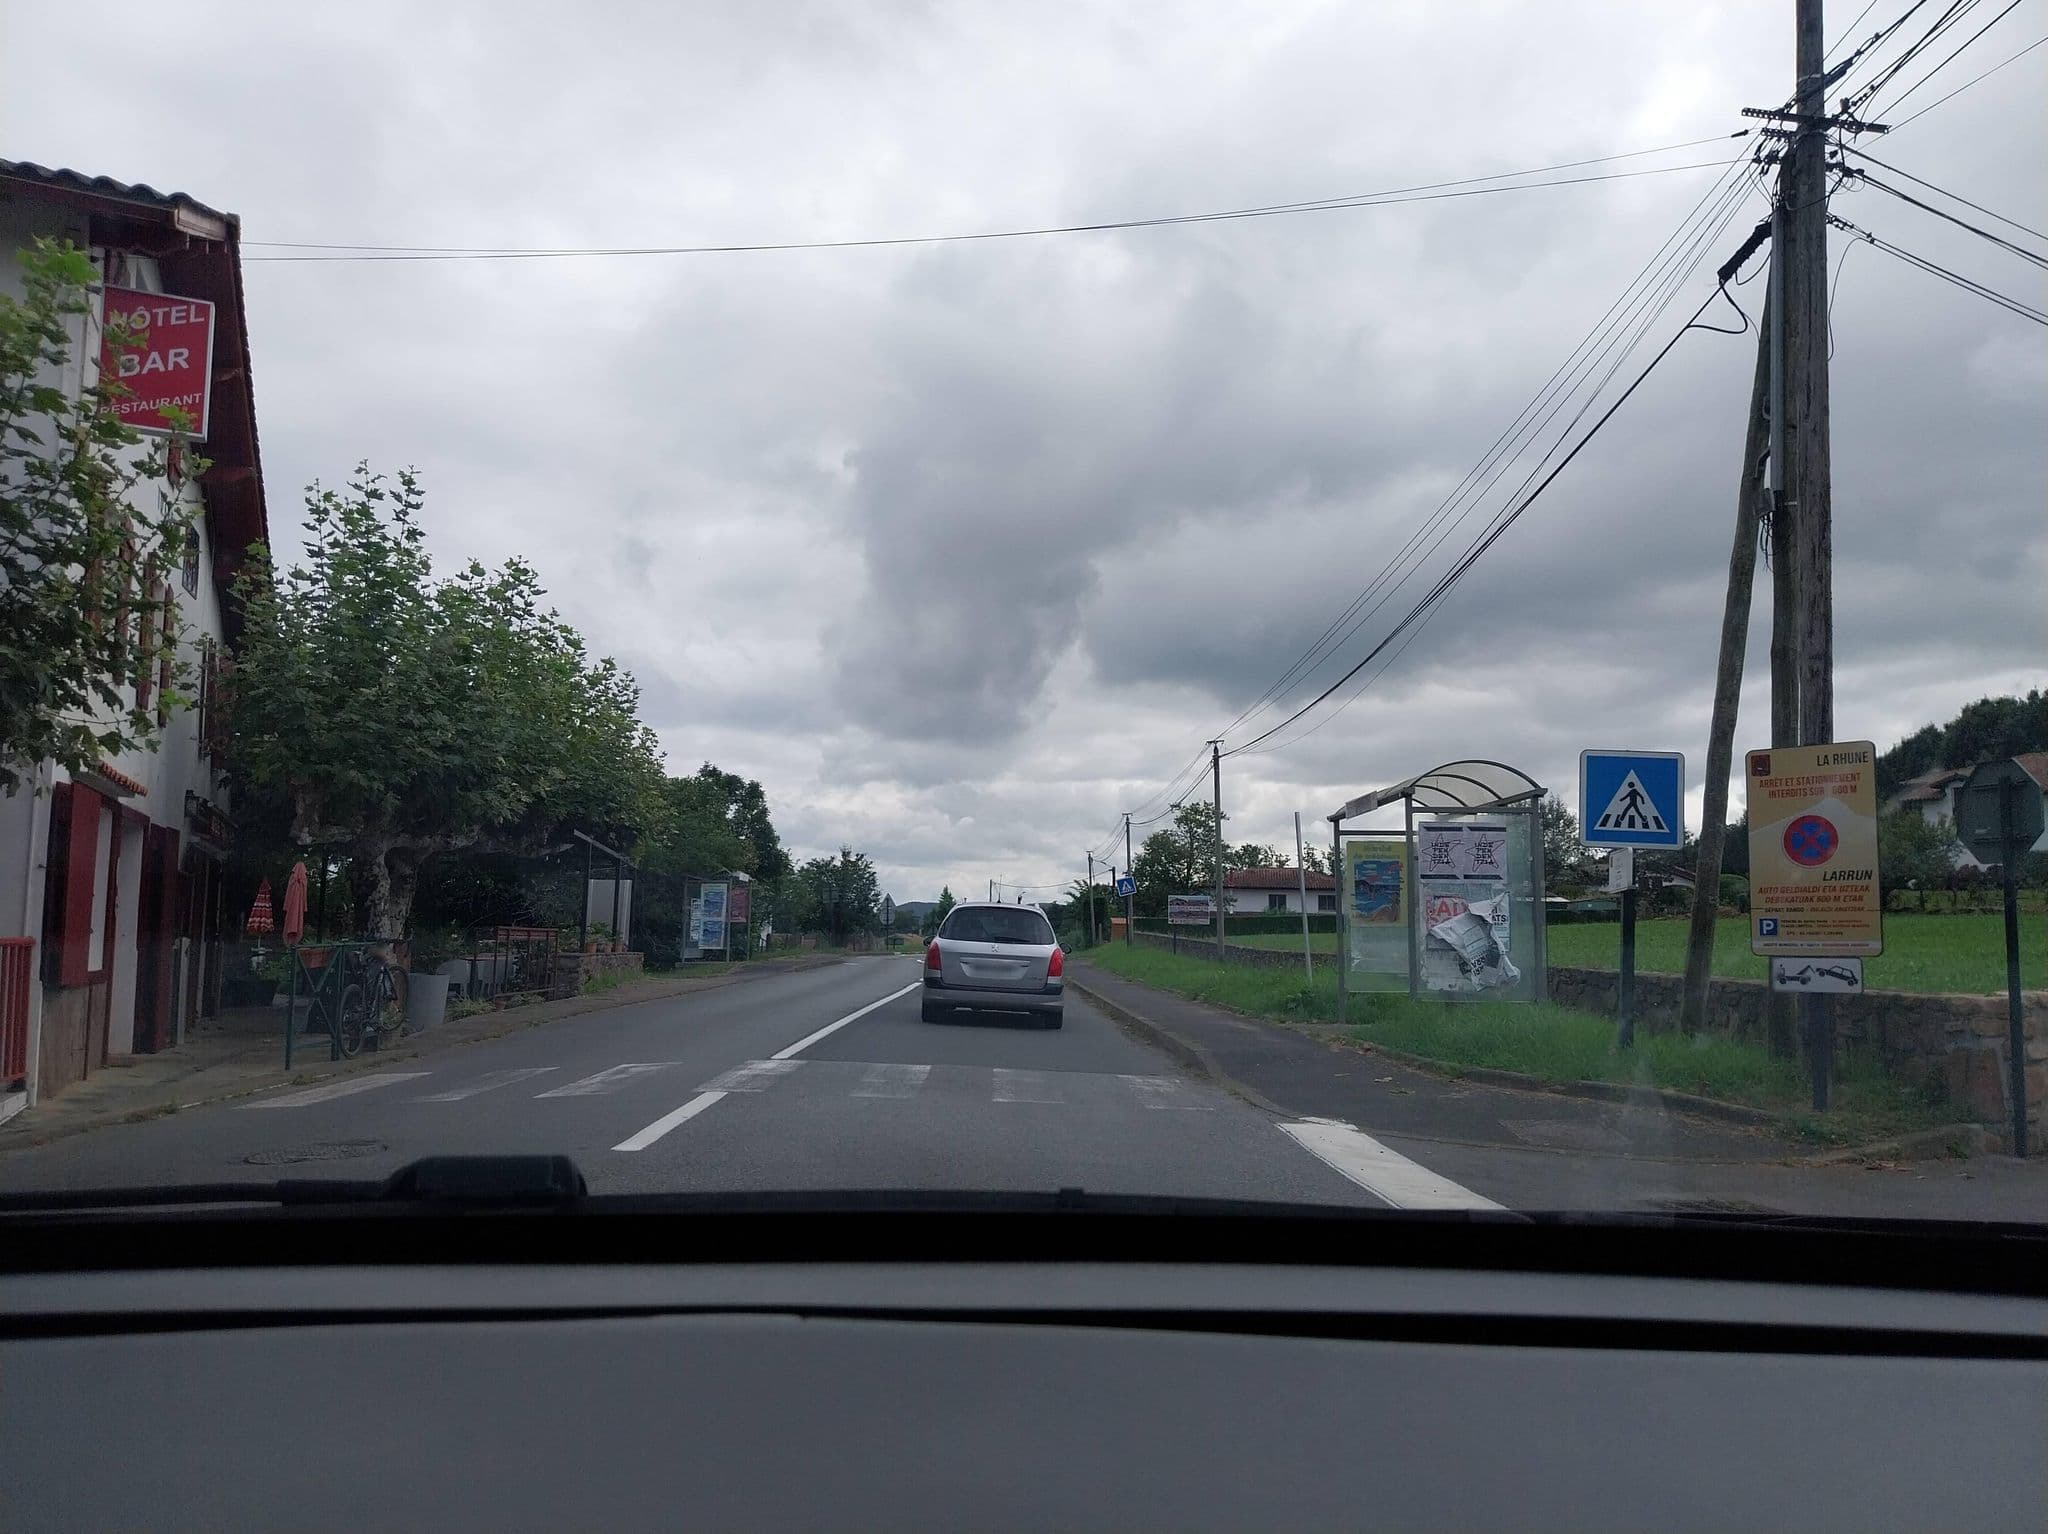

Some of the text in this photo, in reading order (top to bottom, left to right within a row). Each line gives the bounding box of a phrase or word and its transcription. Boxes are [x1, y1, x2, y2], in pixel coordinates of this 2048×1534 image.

[118, 348, 190, 378] BAR
[100, 392, 202, 415] RESTAURANT
[1817, 752, 1868, 766] LA RHUNE
[1786, 778, 1794, 786] ET
[1769, 789, 1806, 798] INTERDITS
[1810, 787, 1824, 795] SUR
[1824, 870, 1872, 881] LARRUN
[1763, 921, 1774, 934] P
